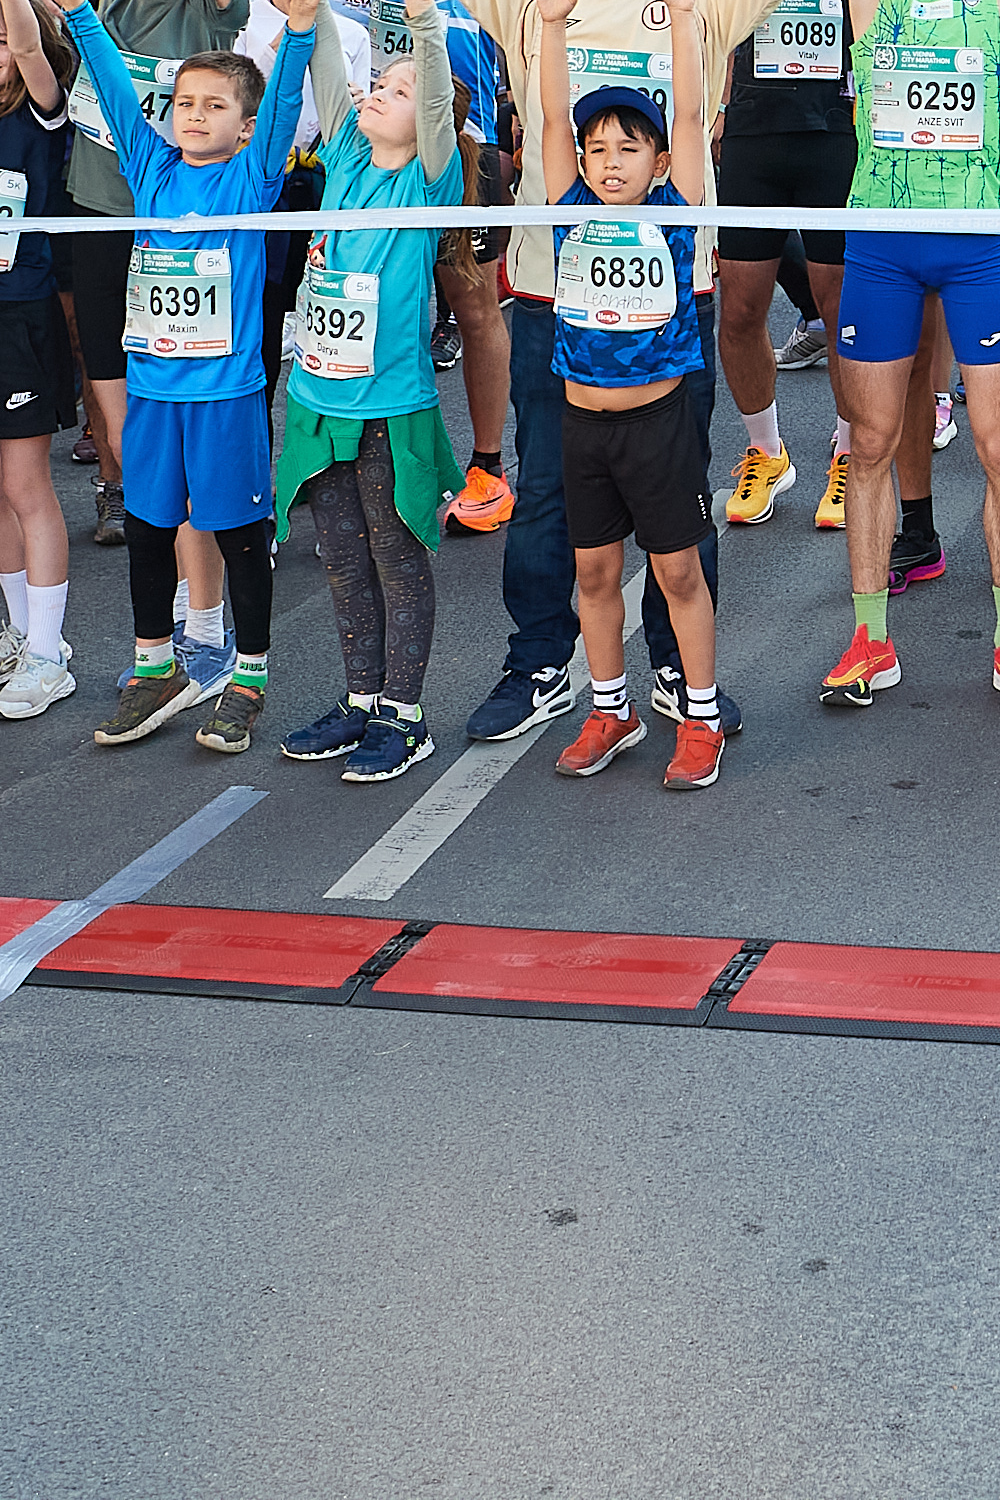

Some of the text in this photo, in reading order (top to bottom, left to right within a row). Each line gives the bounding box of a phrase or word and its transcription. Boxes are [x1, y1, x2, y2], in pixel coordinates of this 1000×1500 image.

[650, 6, 665, 24] U
[780, 22, 836, 46] 6089
[798, 52, 819, 60] Vitaly
[966, 56, 978, 65] 5K
[607, 60, 643, 69] MARATHON
[907, 81, 975, 111] 6259
[918, 117, 964, 127] ANZE SVIT
[7, 180, 20, 189] 5K
[649, 230, 659, 239] 5K
[207, 258, 221, 267] 5K
[591, 257, 664, 288] 6830
[356, 282, 371, 292] 5K
[150, 285, 216, 316] 6391
[583, 288, 653, 310] Leonardo
[306, 301, 365, 341] 6392
[168, 324, 198, 333] Maxim
[317, 342, 338, 355] Darya
[10, 392, 32, 402] NIKE
[239, 661, 266, 671] HUL
